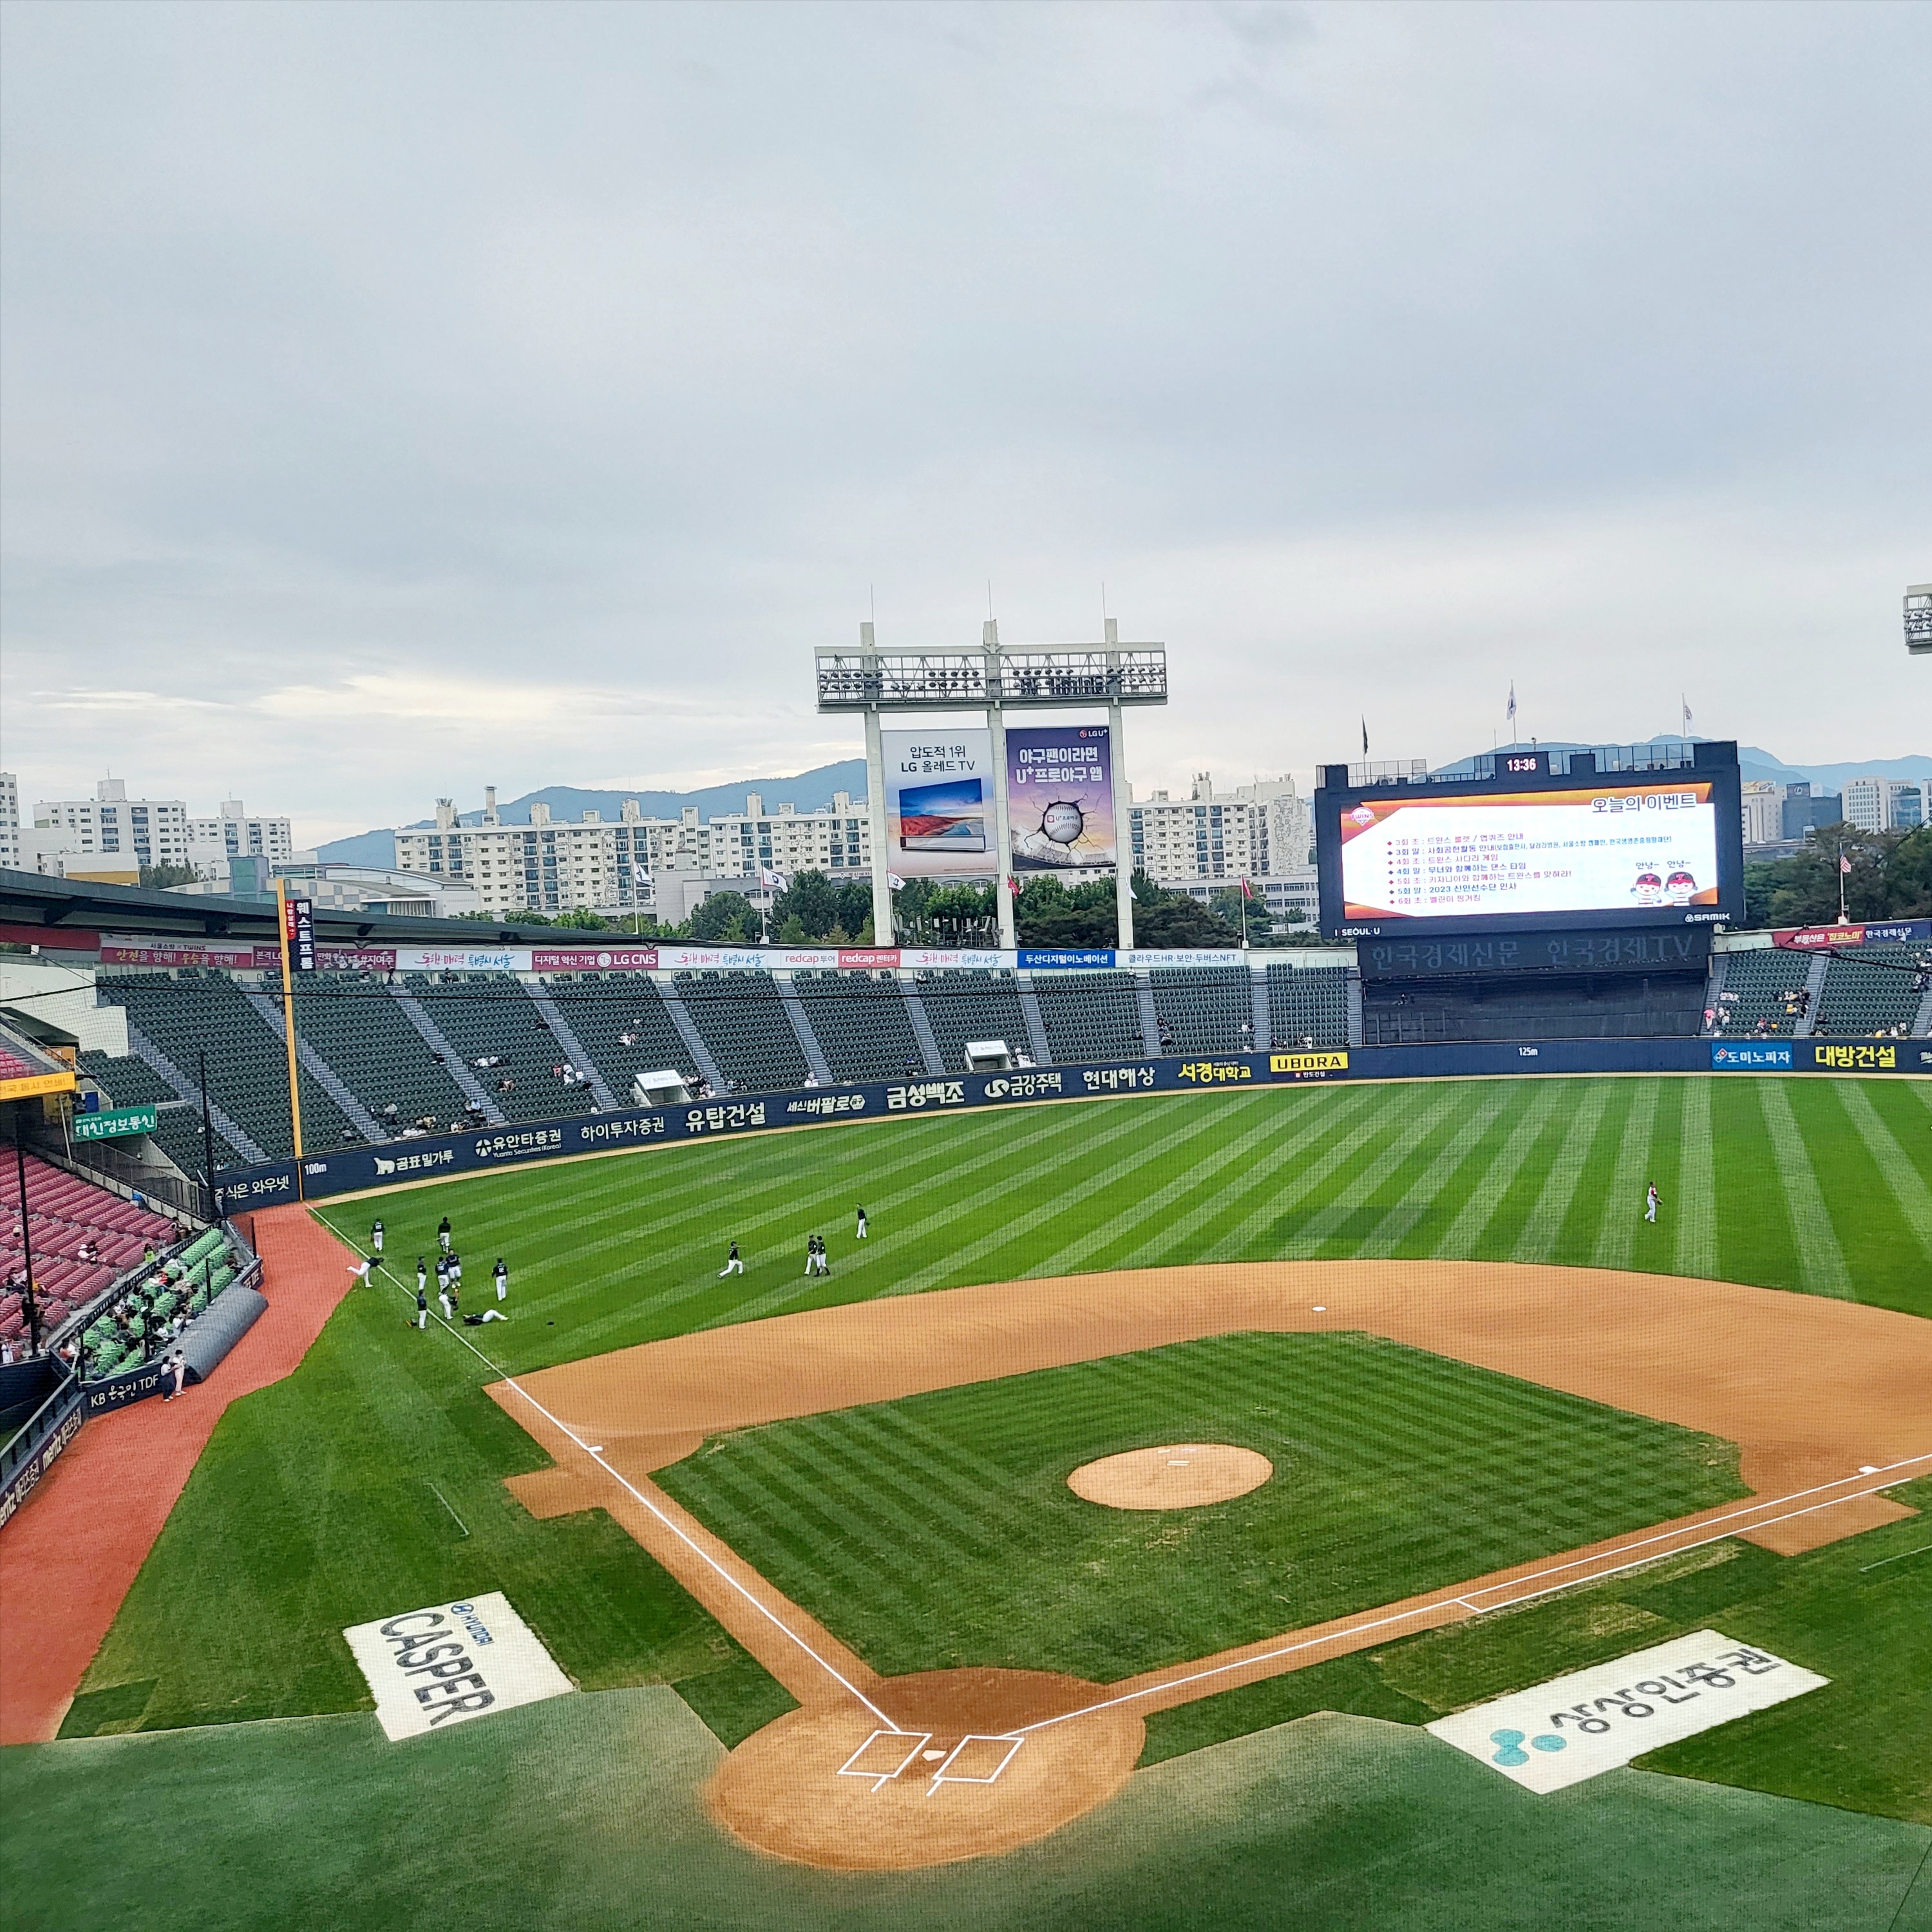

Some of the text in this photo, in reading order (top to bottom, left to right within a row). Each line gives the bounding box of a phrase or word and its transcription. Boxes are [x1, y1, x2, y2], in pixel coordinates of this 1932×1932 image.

[910, 744, 966, 759] 압도적 1위
[1019, 746, 1098, 764] 야구팬이라면
[901, 760, 975, 773] LG 올레드 TV
[1506, 758, 1537, 772] 13:36
[1016, 766, 1103, 784] U+프로야구 앱
[1592, 793, 1696, 813] 오늘의 이벤트
[1454, 884, 1497, 893] 신인선수단
[1692, 913, 1730, 922] SAMIK
[296, 902, 314, 969] 웨스트프롬
[116, 949, 238, 965] 안전을 향해! 우승을 향해!
[467, 954, 492, 967] 특별시
[493, 954, 520, 969] 서울
[535, 954, 656, 965] 디지털 혁신 기업 LG CNS
[722, 953, 744, 966] 특별시
[746, 953, 766, 967] 서울
[785, 954, 835, 963] redcap 투어
[841, 952, 898, 964] redcap 렌터카
[961, 953, 982, 965] 특별시
[983, 953, 1003, 967] 서울
[1371, 941, 1520, 971] 한국경제신문
[1518, 1046, 1538, 1056] 125m
[1727, 1050, 1790, 1064] 도미노피자
[1815, 1045, 1895, 1068] 대방건설
[1277, 1056, 1341, 1069] UBORA
[1083, 1066, 1155, 1090] 현대해상
[1178, 1062, 1252, 1083] 서경대학교
[1010, 1072, 1062, 1097] 금강주택
[887, 1081, 965, 1109] 금성백조
[75, 1115, 155, 1137] 대신정보통신
[685, 1102, 766, 1132] 유탑건설
[581, 1116, 665, 1142] 하이투자증권
[491, 1128, 562, 1151] 유안타증권
[304, 1162, 327, 1176] 100m
[251, 1175, 290, 1195] 와우넷
[91, 1374, 159, 1408] KB 온국민 TDF
[460, 1614, 495, 1647] HYUNDAI
[379, 1613, 495, 1727] CASPER
[1549, 1649, 1782, 1734] 상상인증권
